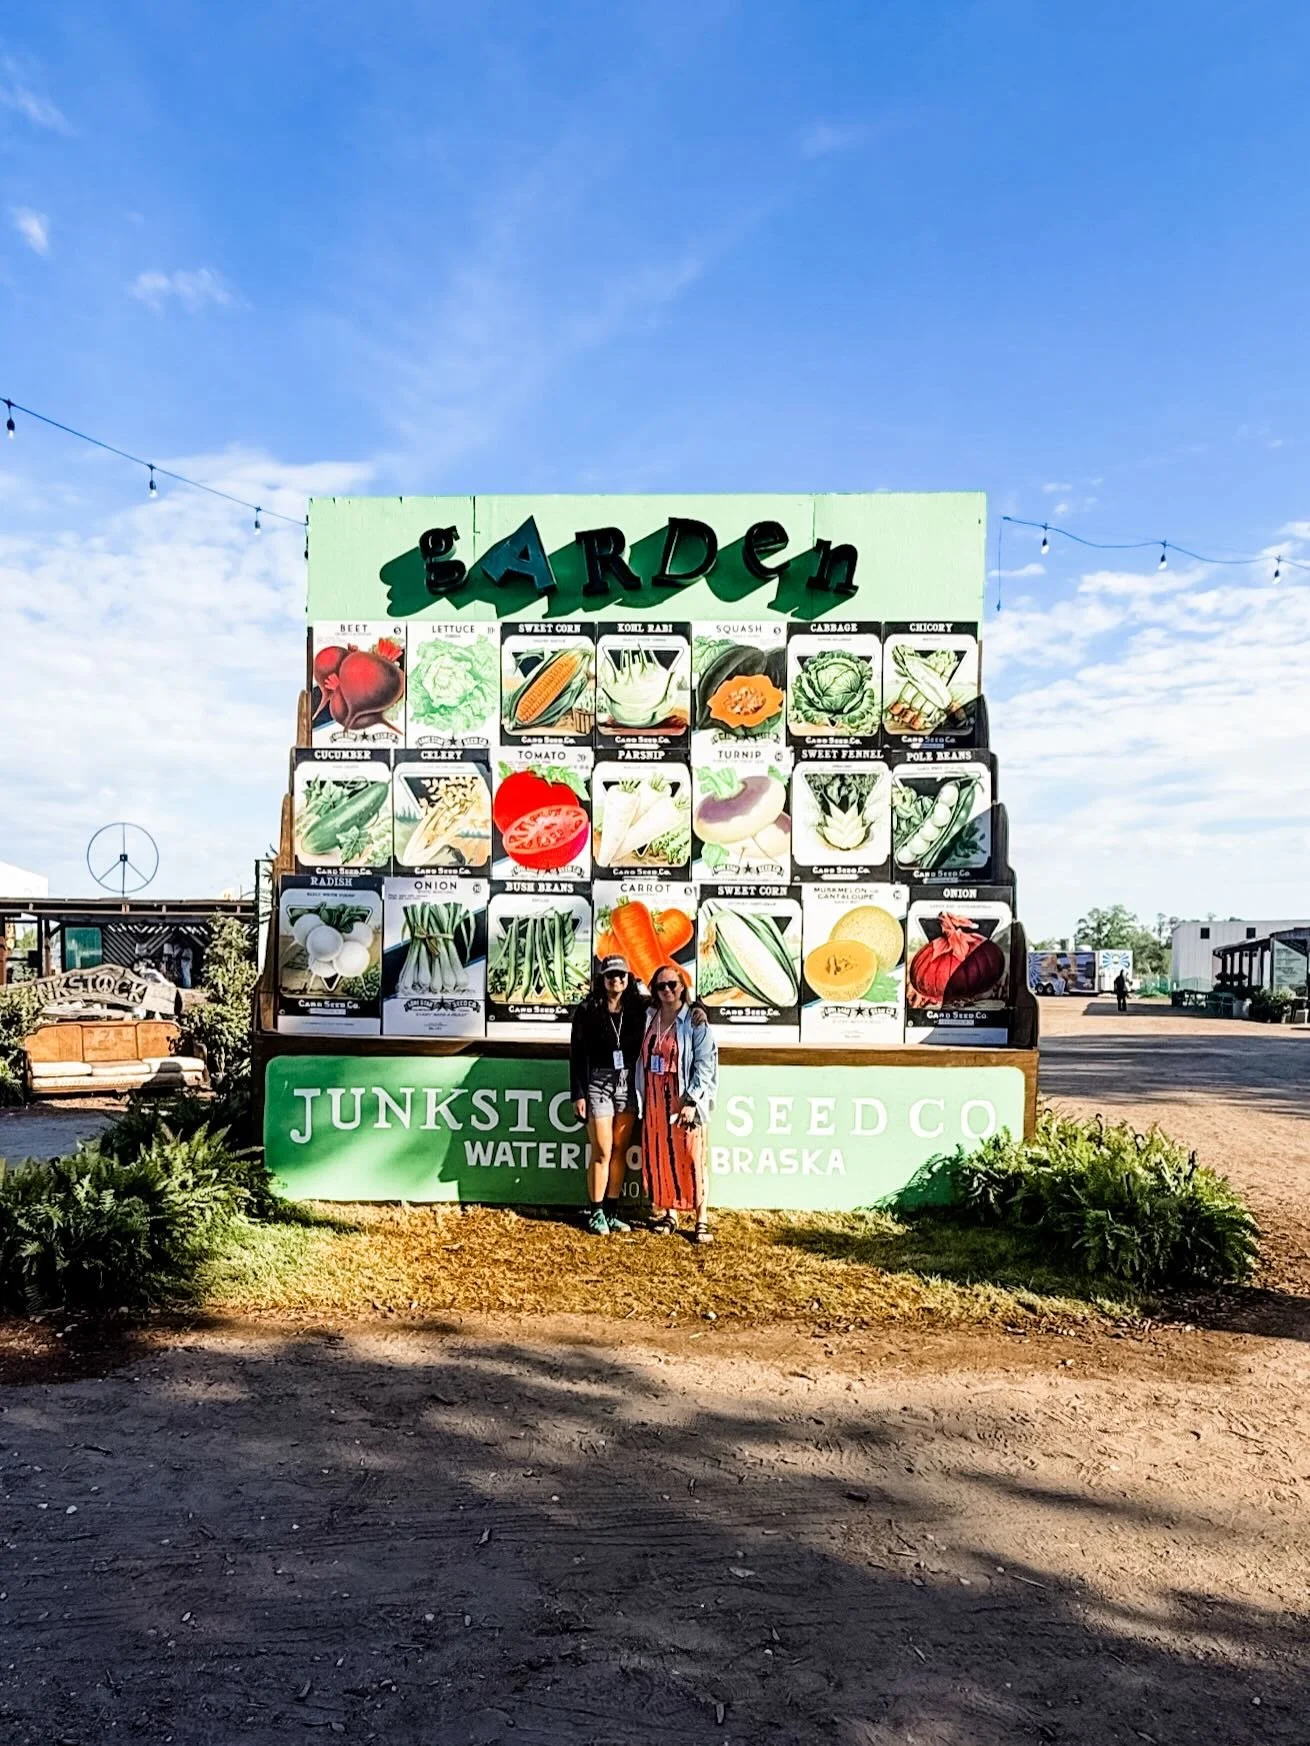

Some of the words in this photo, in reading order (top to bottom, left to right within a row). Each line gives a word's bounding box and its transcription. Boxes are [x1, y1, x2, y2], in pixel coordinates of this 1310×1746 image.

[340, 624, 368, 633] BEET
[432, 624, 475, 633] LETTUCE
[518, 623, 553, 633] SWEET
[556, 623, 581, 633] CORN
[617, 623, 645, 633] KOHL
[648, 623, 673, 633] RABI
[716, 624, 762, 633] SQUASH
[810, 623, 858, 633] CABBAGE
[909, 623, 953, 633] CHICORY
[314, 750, 371, 760] CUCUMBER
[421, 750, 463, 760] CELERY
[518, 750, 566, 760] TOMATO
[617, 750, 665, 760] PARSNIP
[718, 750, 762, 759] TURNIP
[801, 749, 838, 759] SWEET
[841, 749, 884, 759] FENNEL
[906, 752, 933, 761] POLE
[936, 751, 972, 760] BEANS
[310, 877, 352, 887] RADISH
[414, 880, 457, 890] ONION
[505, 882, 535, 892] BUSH
[538, 883, 574, 893] BEANS
[620, 883, 671, 893] CARROT
[717, 886, 756, 896] SWEET
[759, 886, 788, 896] CORN
[943, 888, 977, 899] ONION
[725, 1096, 888, 1137] SEED
[909, 1098, 997, 1139] CO
